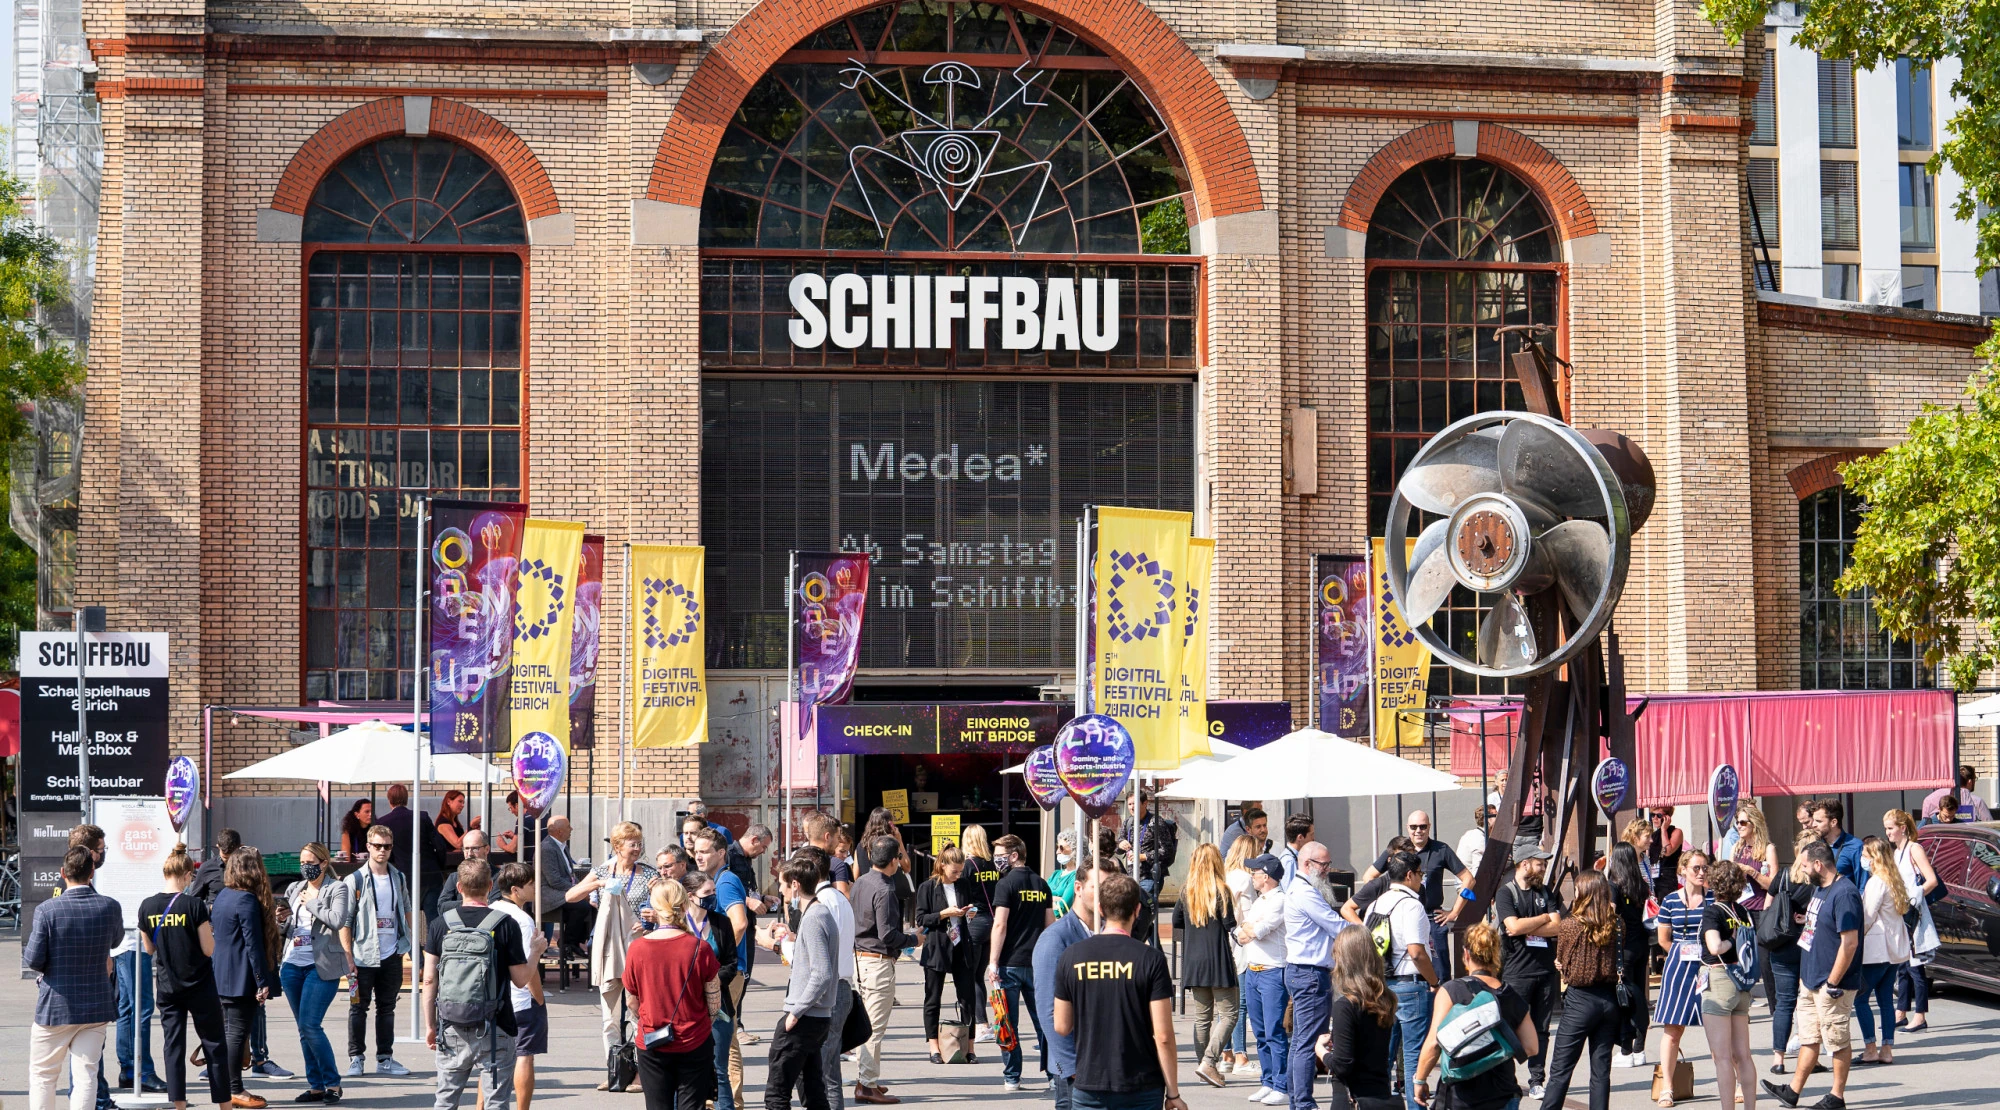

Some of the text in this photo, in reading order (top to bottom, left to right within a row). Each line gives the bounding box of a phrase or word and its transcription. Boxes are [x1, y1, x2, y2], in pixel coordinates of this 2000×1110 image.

[788, 273, 1120, 352] SCHIFFBAU
[331, 429, 394, 456] SALLE
[902, 534, 1057, 565] Samstag
[880, 576, 914, 608] im
[38, 641, 151, 667] SCHIFFBAU
[642, 668, 697, 680] DIGITAL
[1105, 668, 1165, 684] DIGITAL
[1105, 685, 1173, 701] FESTIVAL
[642, 695, 696, 708] ZÜRICH
[1104, 703, 1160, 719] ZÜRICH
[843, 725, 912, 737] CHECK-IN
[966, 717, 1030, 729] EINGANG
[95, 731, 123, 743] Box
[126, 731, 139, 743] &
[960, 731, 1036, 742] MIT BADGE
[1064, 718, 1124, 750] LAB
[58, 743, 132, 756] Machbox
[517, 734, 556, 762] LAB
[1600, 760, 1625, 781] LAB
[124, 830, 153, 842] gast
[974, 870, 1000, 883] TEAM
[1019, 890, 1047, 903] TEAM
[147, 913, 186, 928] TEAM
[1073, 961, 1134, 981] TEAM
